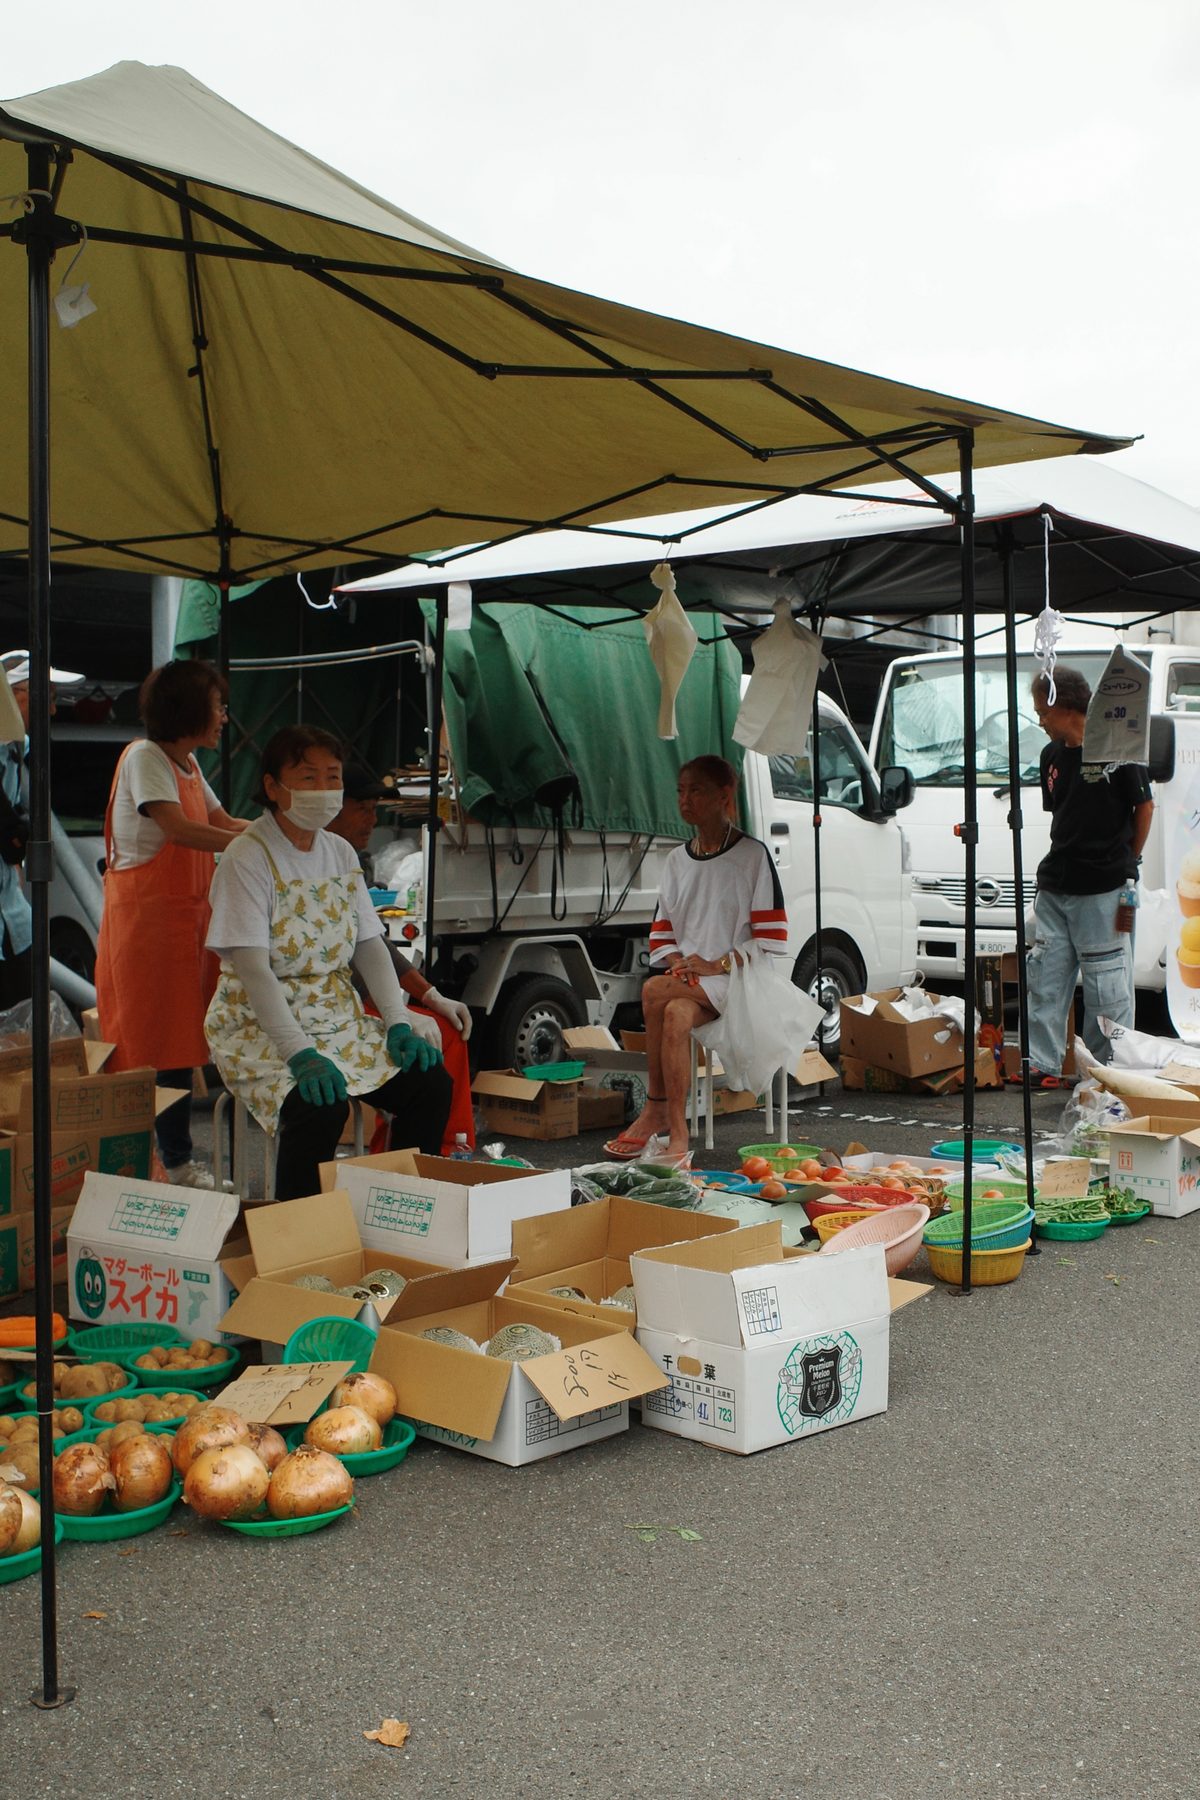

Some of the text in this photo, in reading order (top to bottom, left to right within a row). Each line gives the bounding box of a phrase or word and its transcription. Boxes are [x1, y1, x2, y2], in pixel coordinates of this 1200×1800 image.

[1114, 707, 1127, 719] 30
[103, 1257, 180, 1287] マダーボール
[108, 1279, 179, 1324] スイカ
[662, 1354, 673, 1369] 千
[808, 1360, 835, 1373] Premium
[704, 1363, 716, 1381] 葉
[812, 1370, 831, 1381] Melon
[696, 1402, 709, 1421] 4L
[717, 1407, 732, 1423] 723
